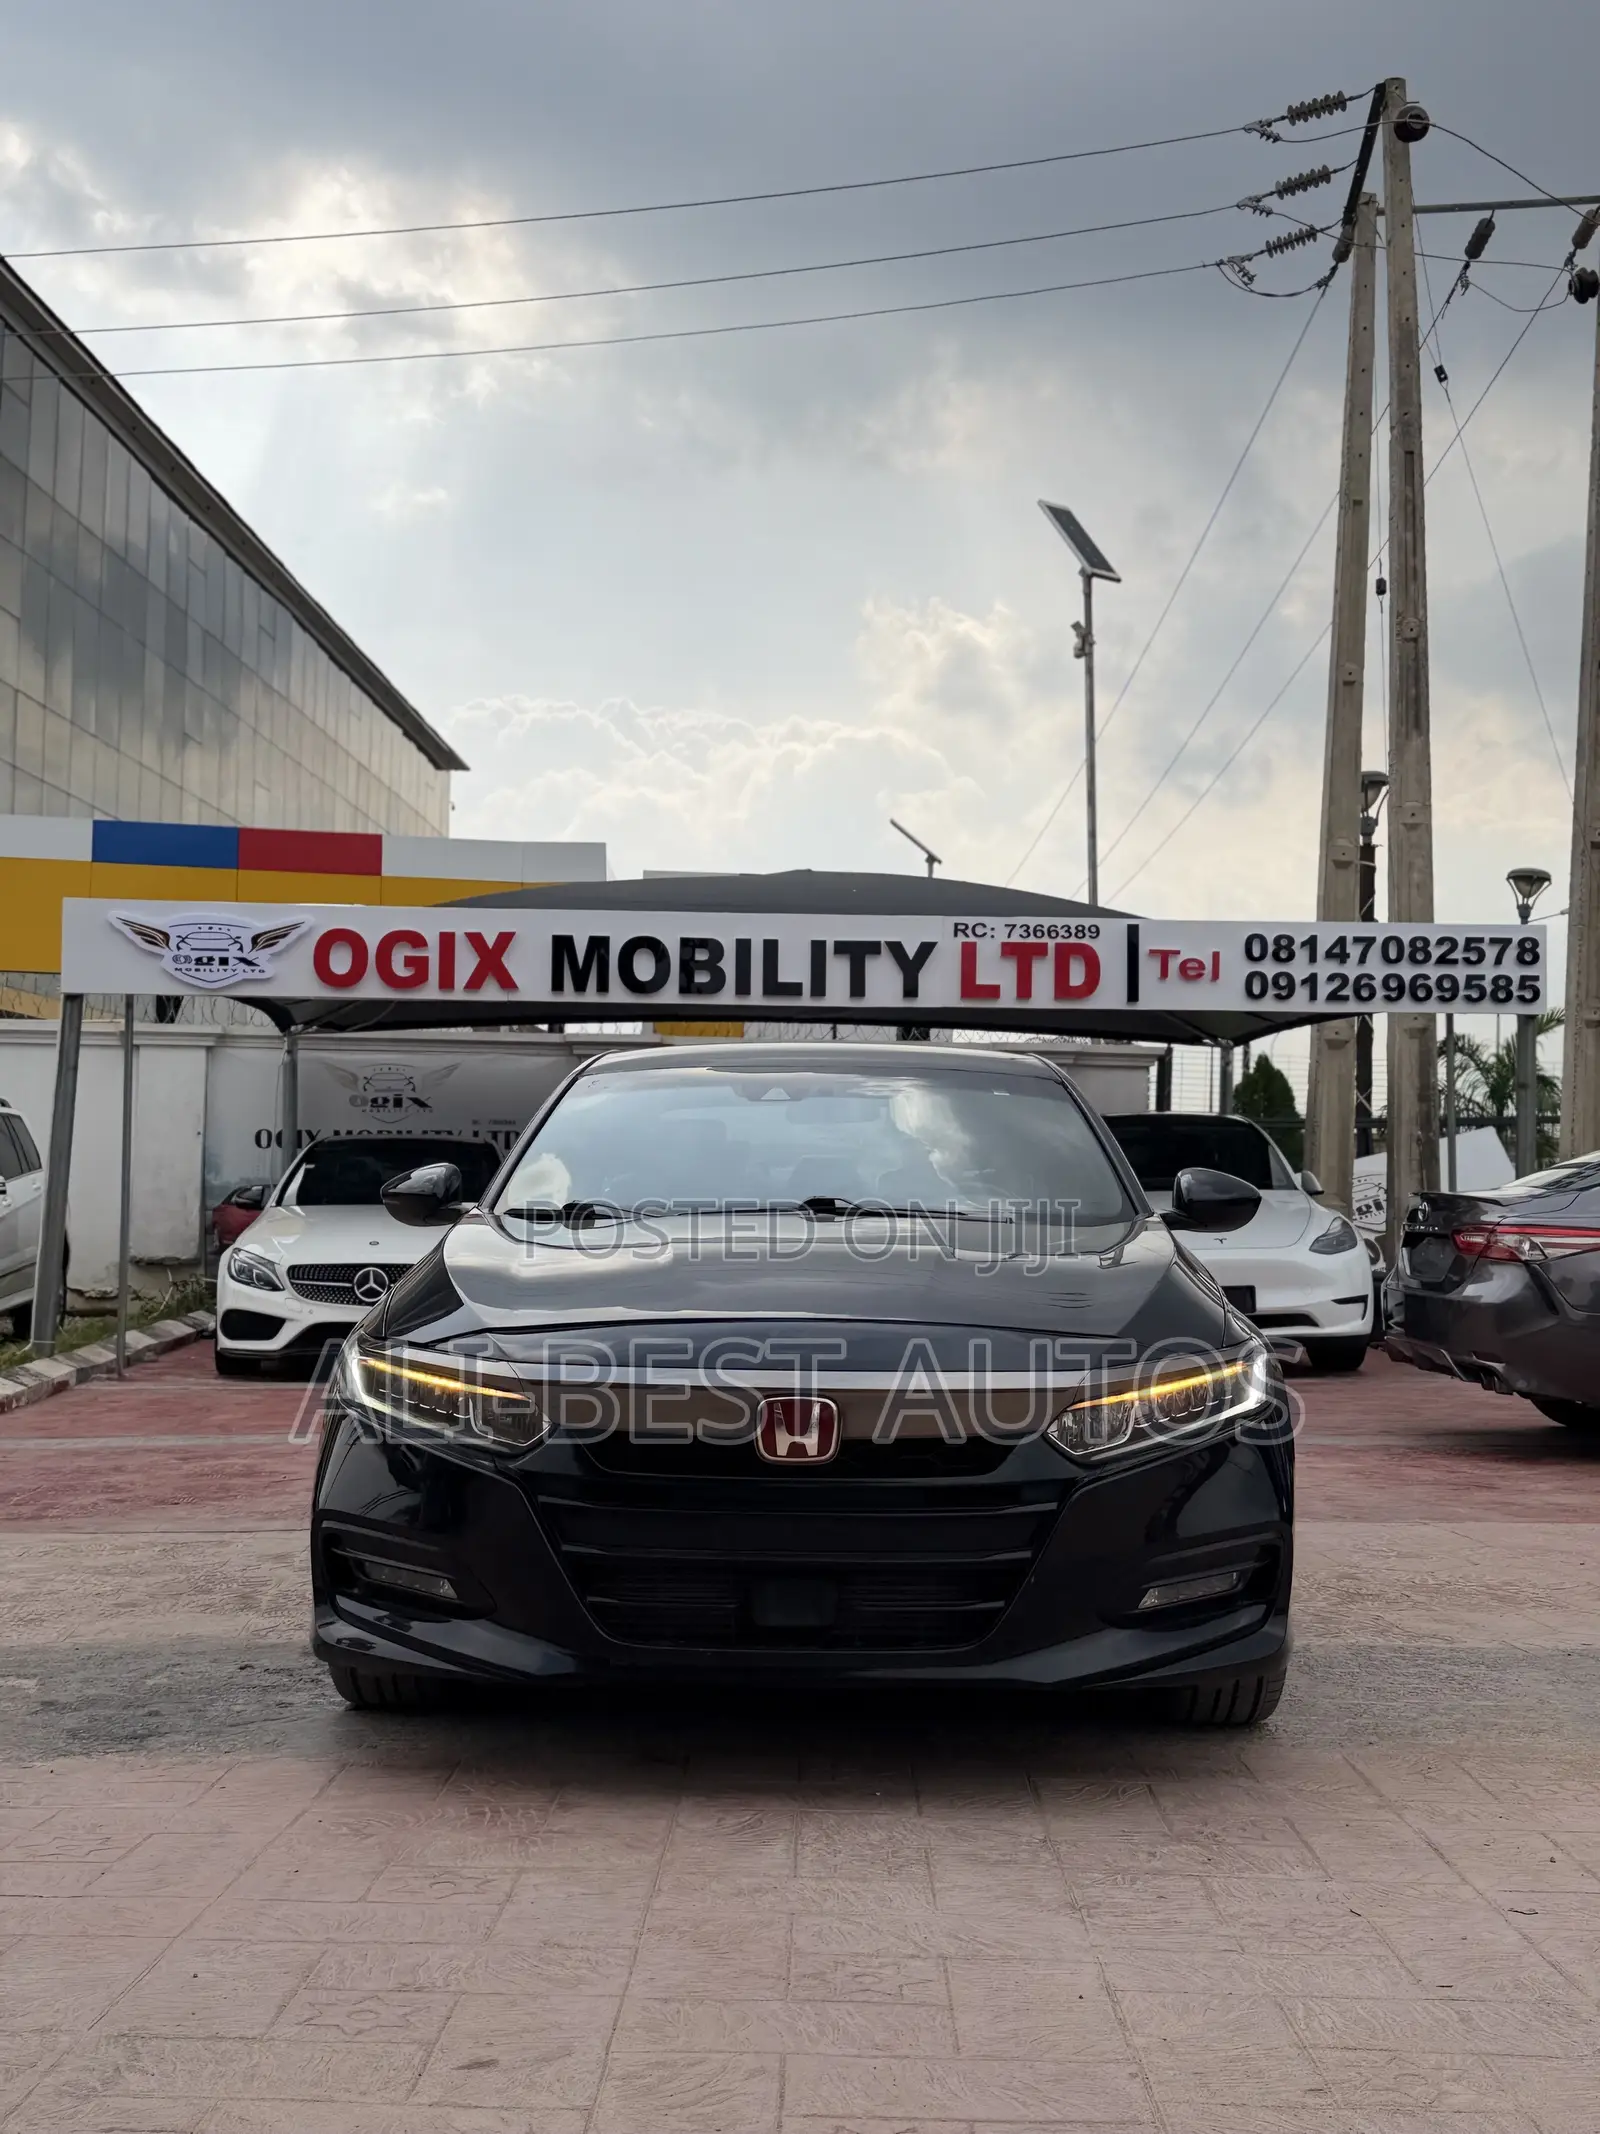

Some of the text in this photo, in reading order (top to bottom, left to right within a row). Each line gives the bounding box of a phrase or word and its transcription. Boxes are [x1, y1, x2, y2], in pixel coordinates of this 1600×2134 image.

[953, 922, 1101, 939] RC: 7366389
[313, 928, 1101, 1001] OGIX MOBILITY LTD
[1148, 933, 1541, 982] Tel 08147082578
[1244, 971, 1541, 1004] 09126969585
